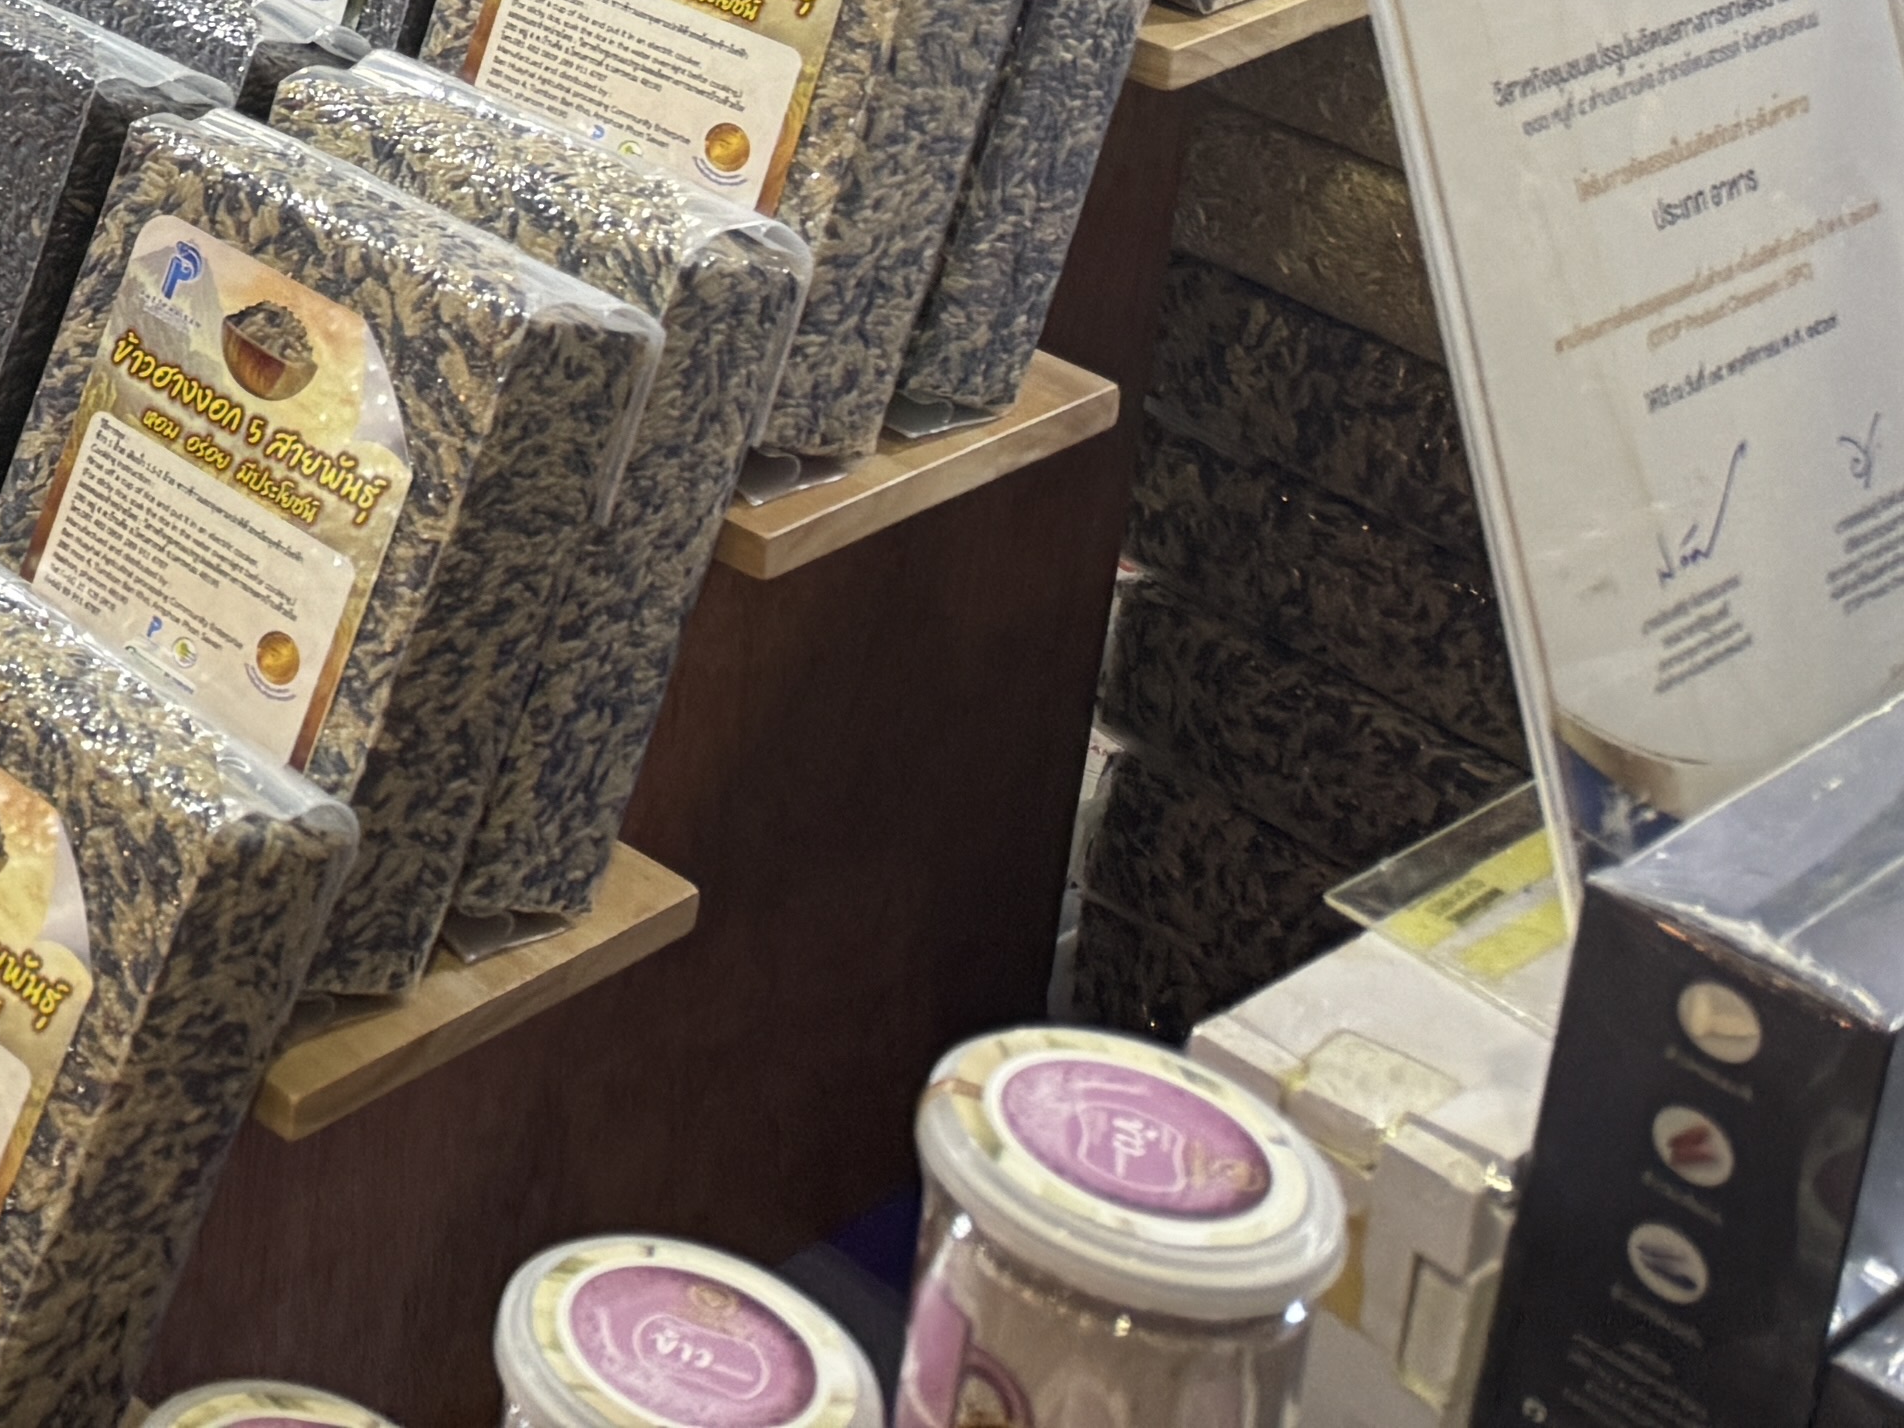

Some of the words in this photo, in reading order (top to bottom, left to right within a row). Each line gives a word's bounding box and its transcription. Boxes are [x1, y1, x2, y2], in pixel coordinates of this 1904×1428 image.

[110, 335, 245, 428] ข้าวฮางงอก
[244, 417, 265, 447] 5
[261, 419, 391, 522] สายพันธุ์
[141, 405, 181, 440] หอม
[184, 430, 233, 469] อร่อย
[235, 461, 322, 520] มีประโยชน์
